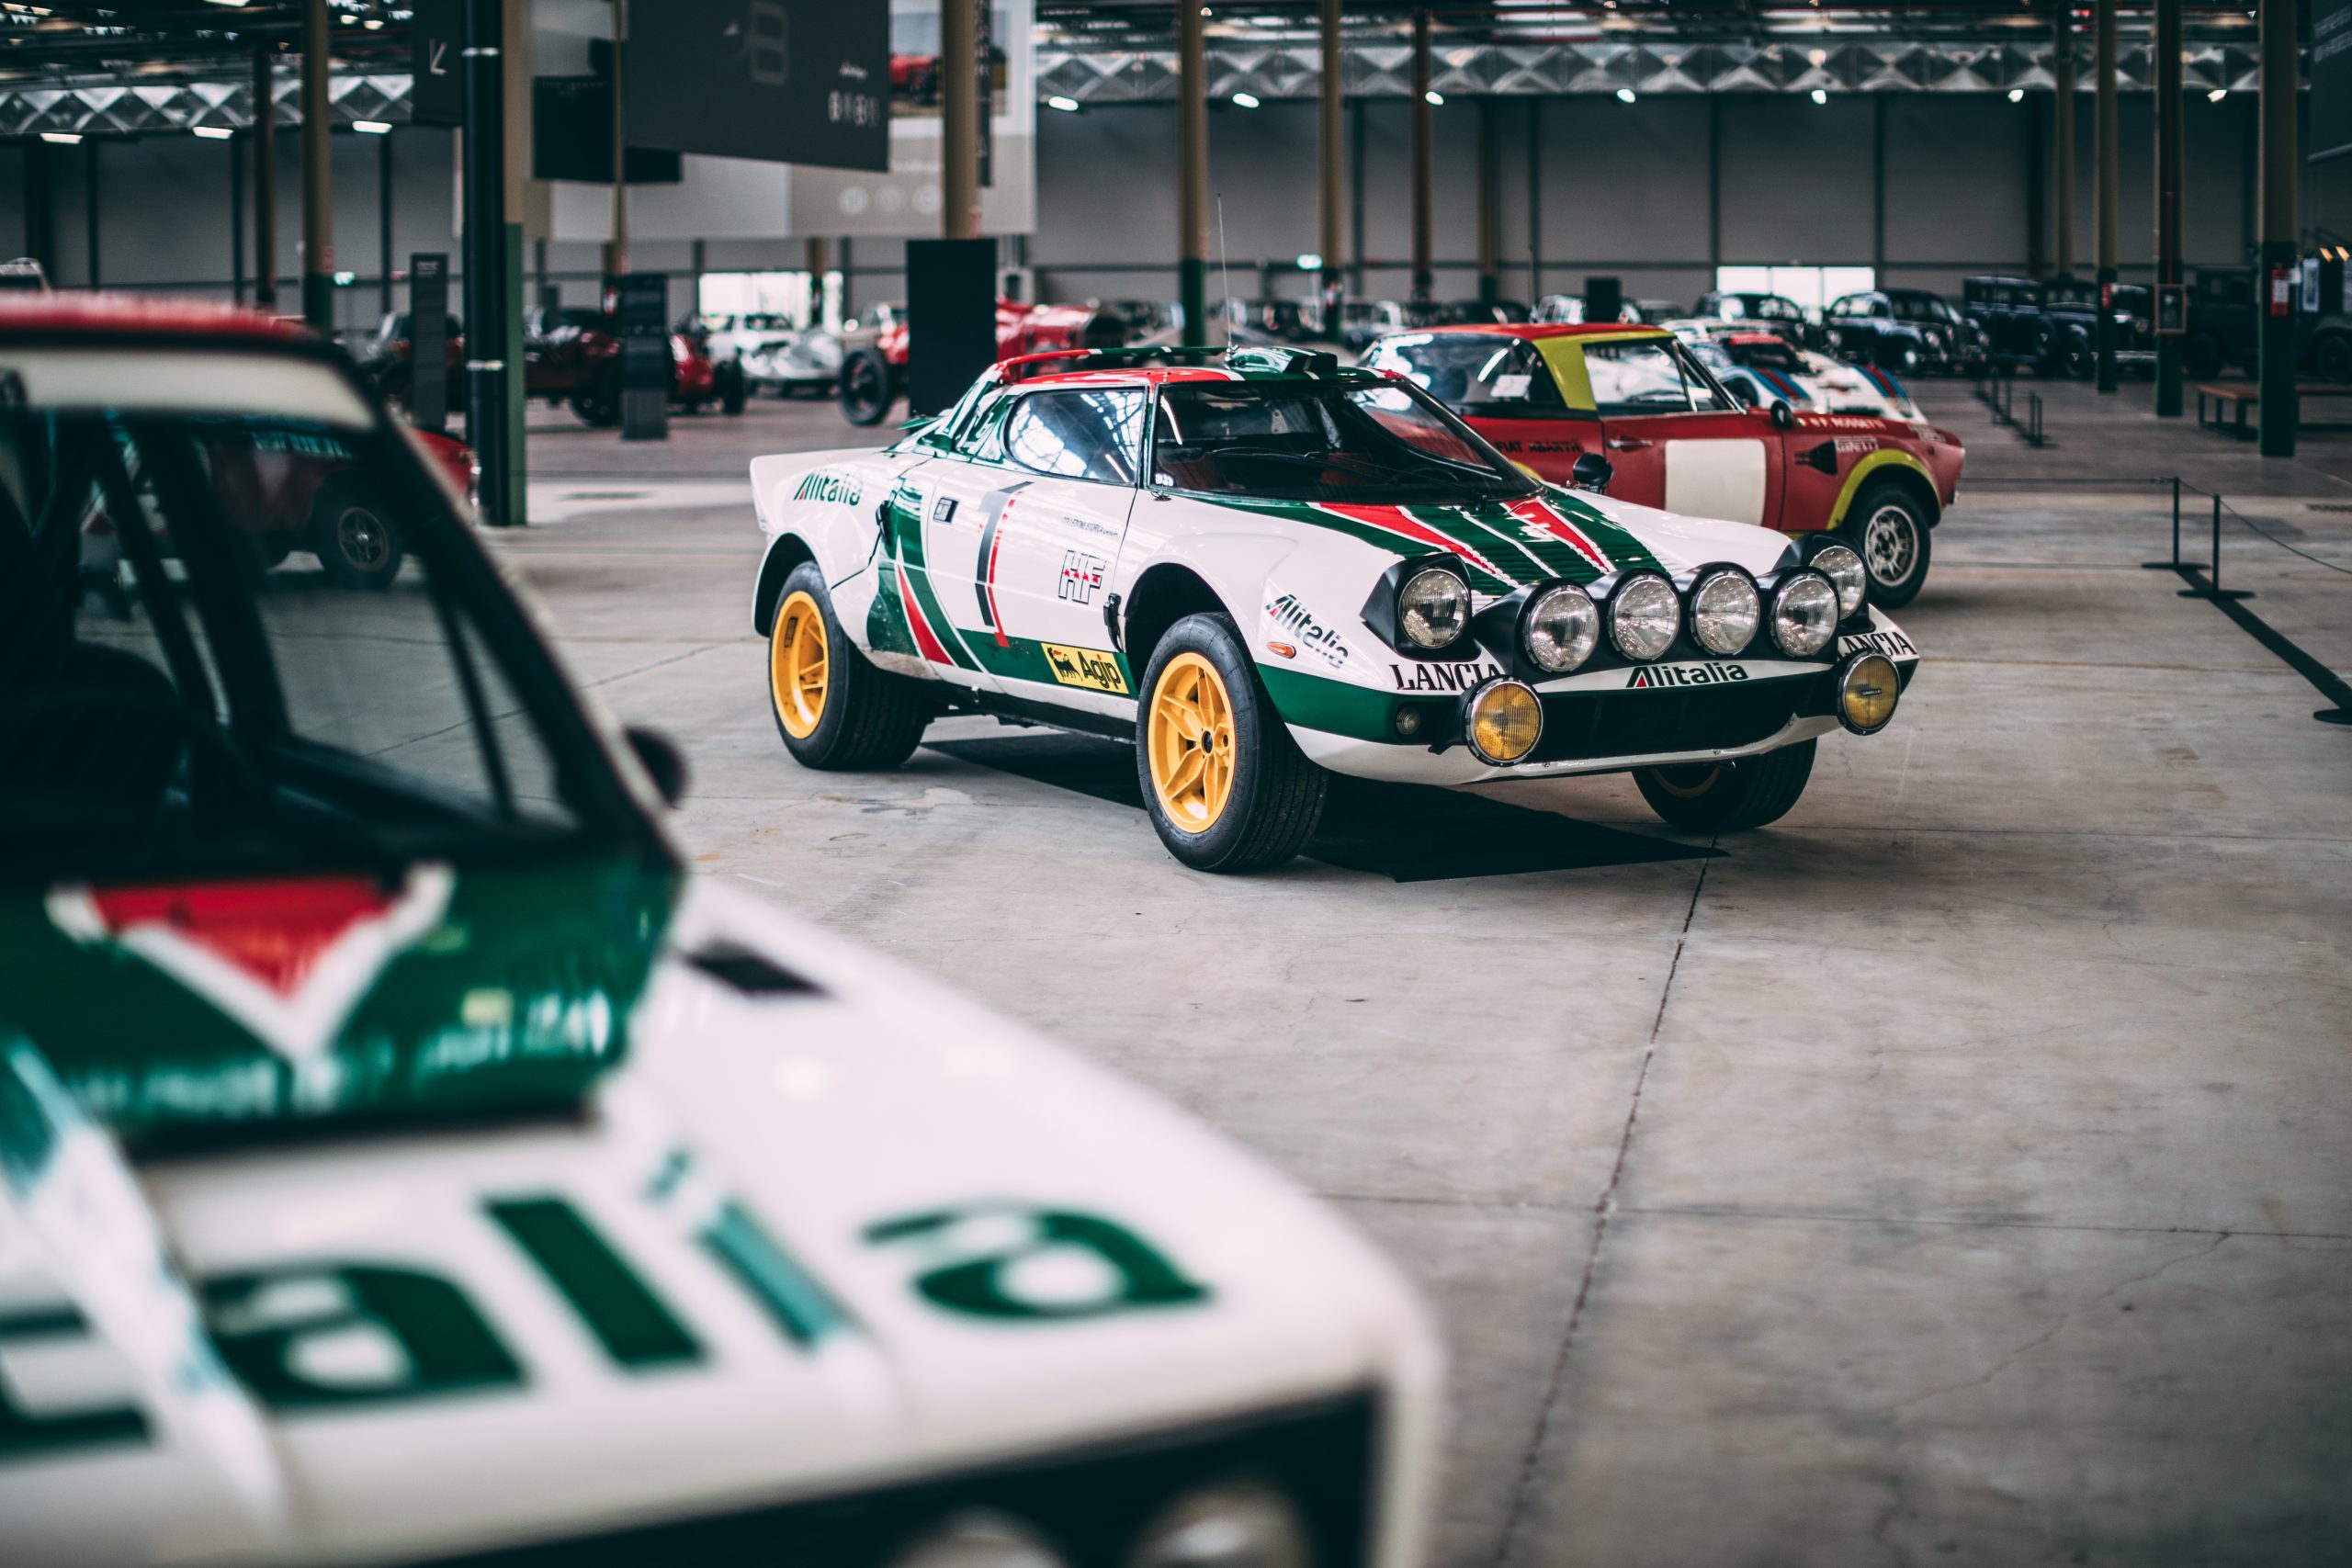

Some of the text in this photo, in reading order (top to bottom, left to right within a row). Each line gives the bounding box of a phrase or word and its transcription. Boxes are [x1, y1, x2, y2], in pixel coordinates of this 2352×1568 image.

[1494, 441, 1522, 453] FIAT
[1834, 435, 1880, 454] PIRELLI
[793, 473, 862, 506] Alitalia
[1058, 549, 1107, 605] HF
[1266, 593, 1349, 669] Alitalia
[1838, 631, 1918, 656] ANCIA
[1077, 650, 1122, 690] Agip
[1625, 661, 1749, 689] Alitalia
